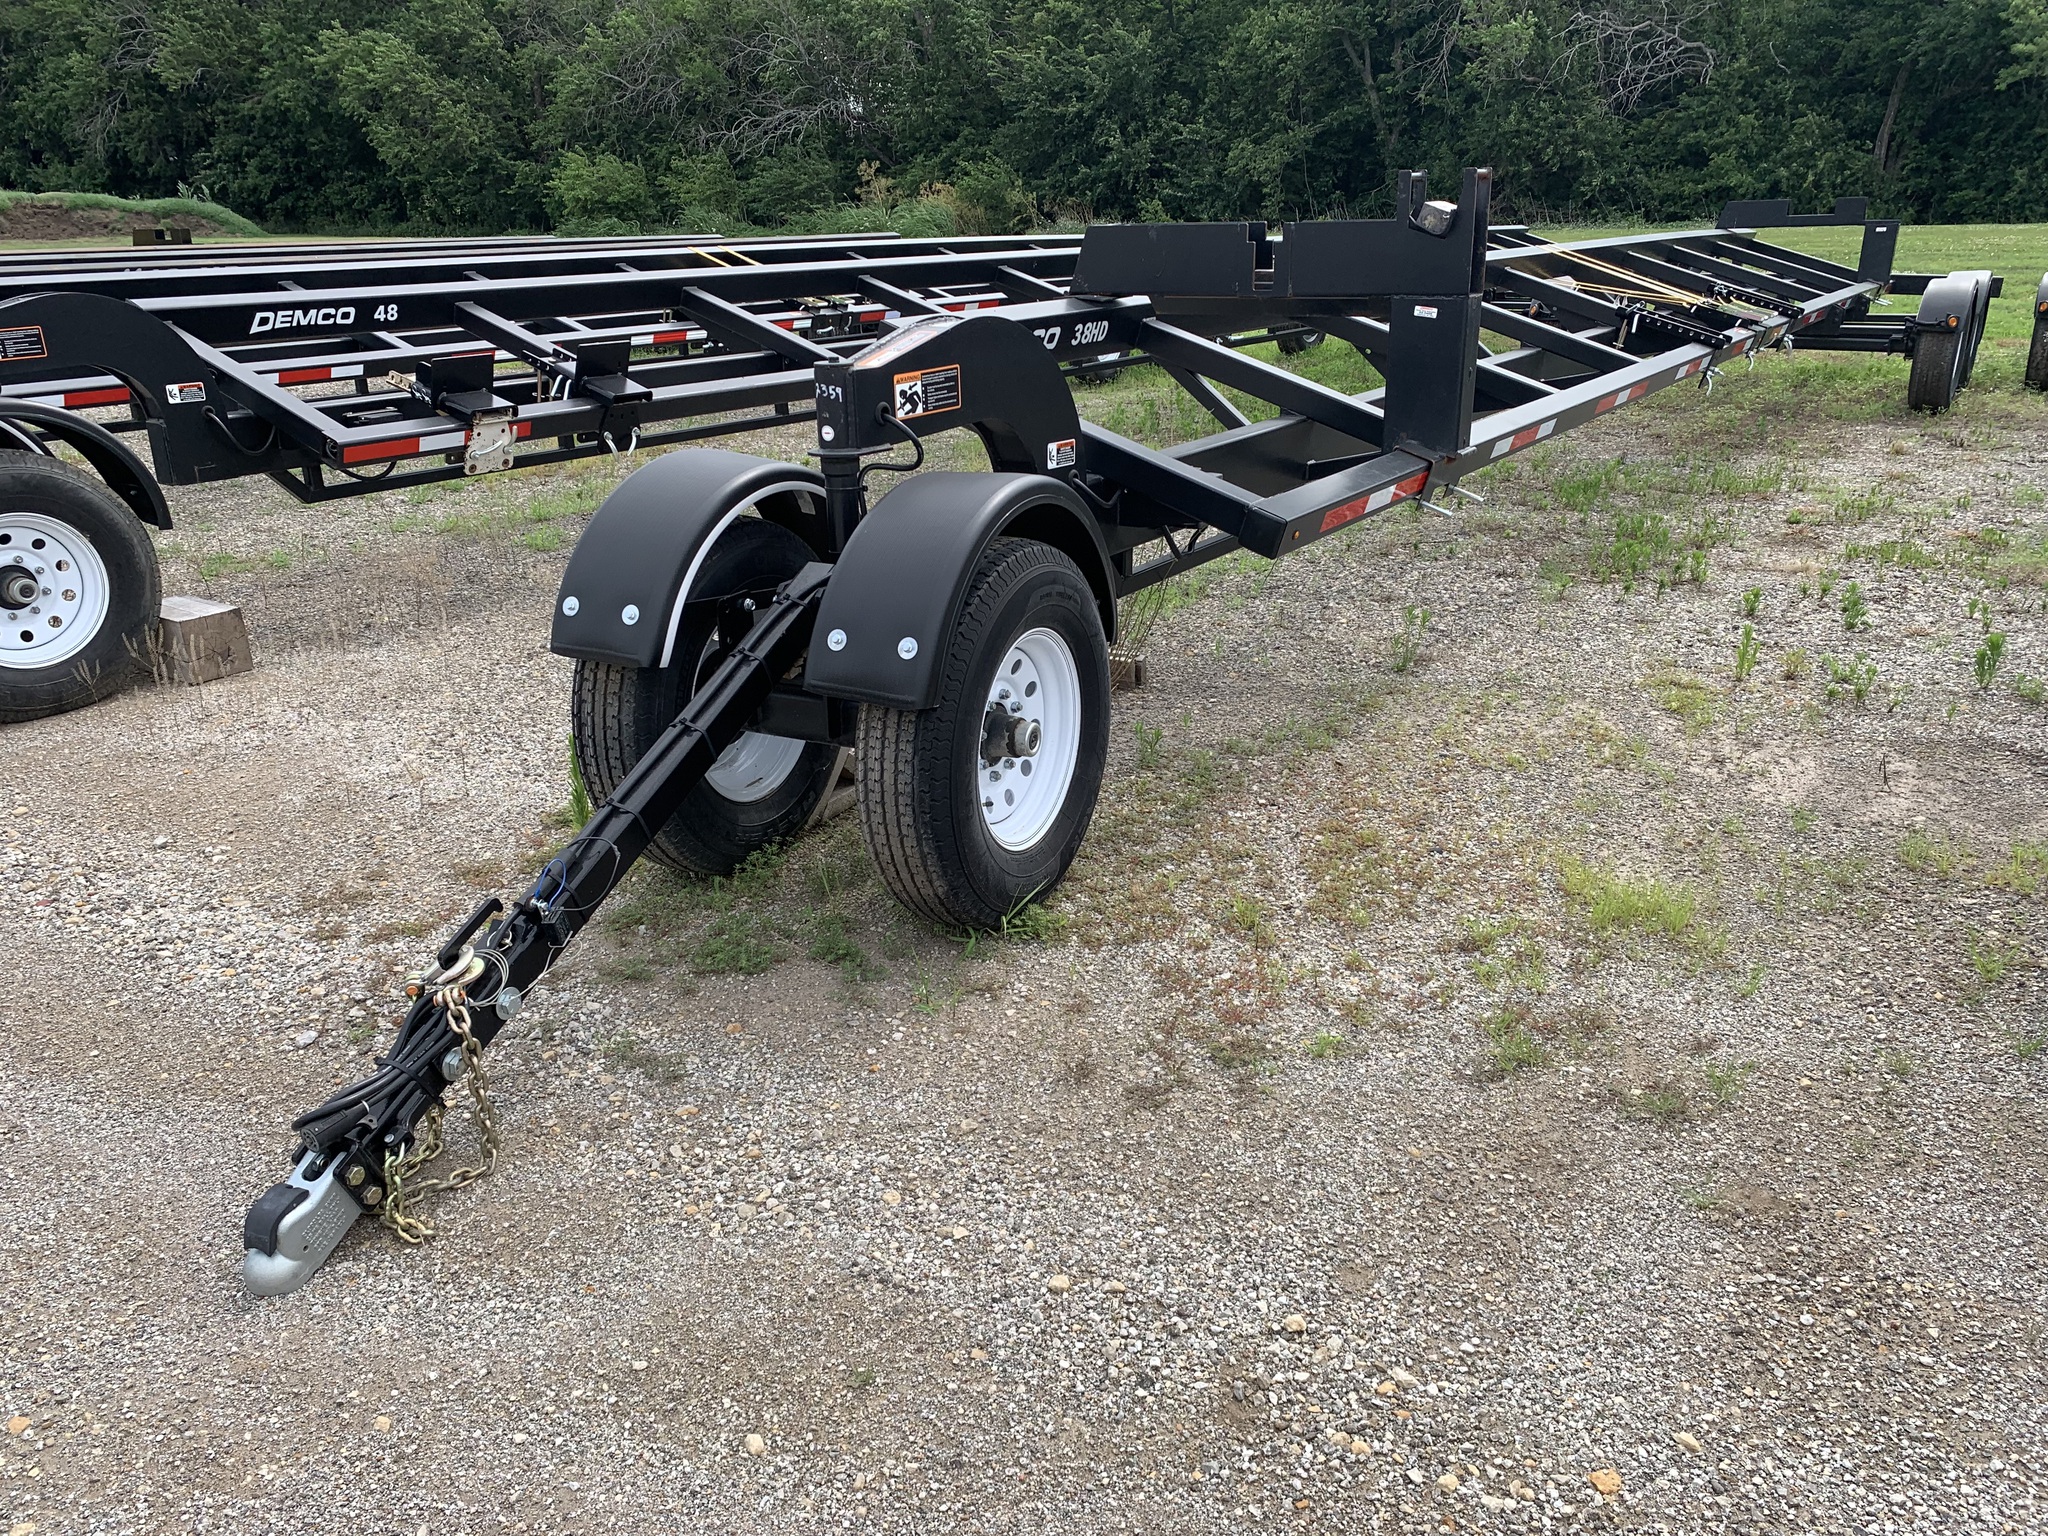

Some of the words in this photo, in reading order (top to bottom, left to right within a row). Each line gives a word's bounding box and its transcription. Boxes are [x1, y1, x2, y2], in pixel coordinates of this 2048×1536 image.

[249, 307, 356, 334] DEMCO
[374, 304, 398, 322] 48
[1071, 320, 1109, 346] 38HD
